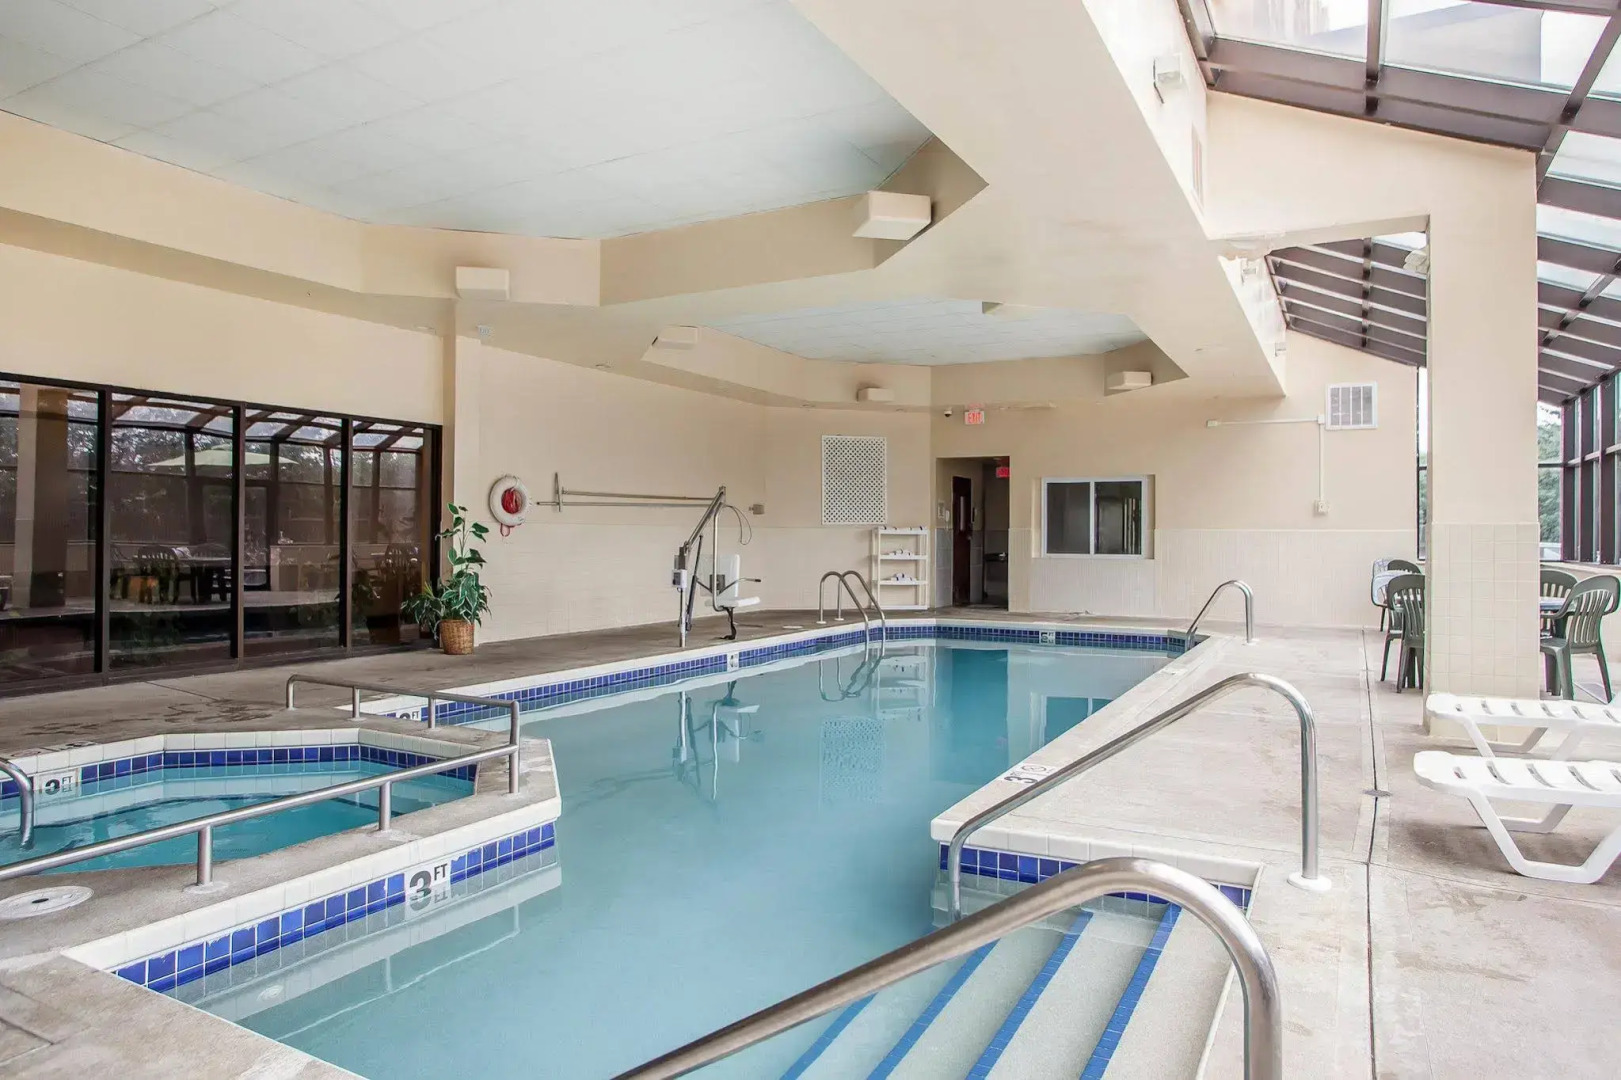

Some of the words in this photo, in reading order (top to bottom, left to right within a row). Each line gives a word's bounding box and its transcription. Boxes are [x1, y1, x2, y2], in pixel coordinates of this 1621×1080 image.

[967, 411, 983, 424] EXIT
[409, 870, 432, 903] 3
[433, 863, 448, 881] FT
